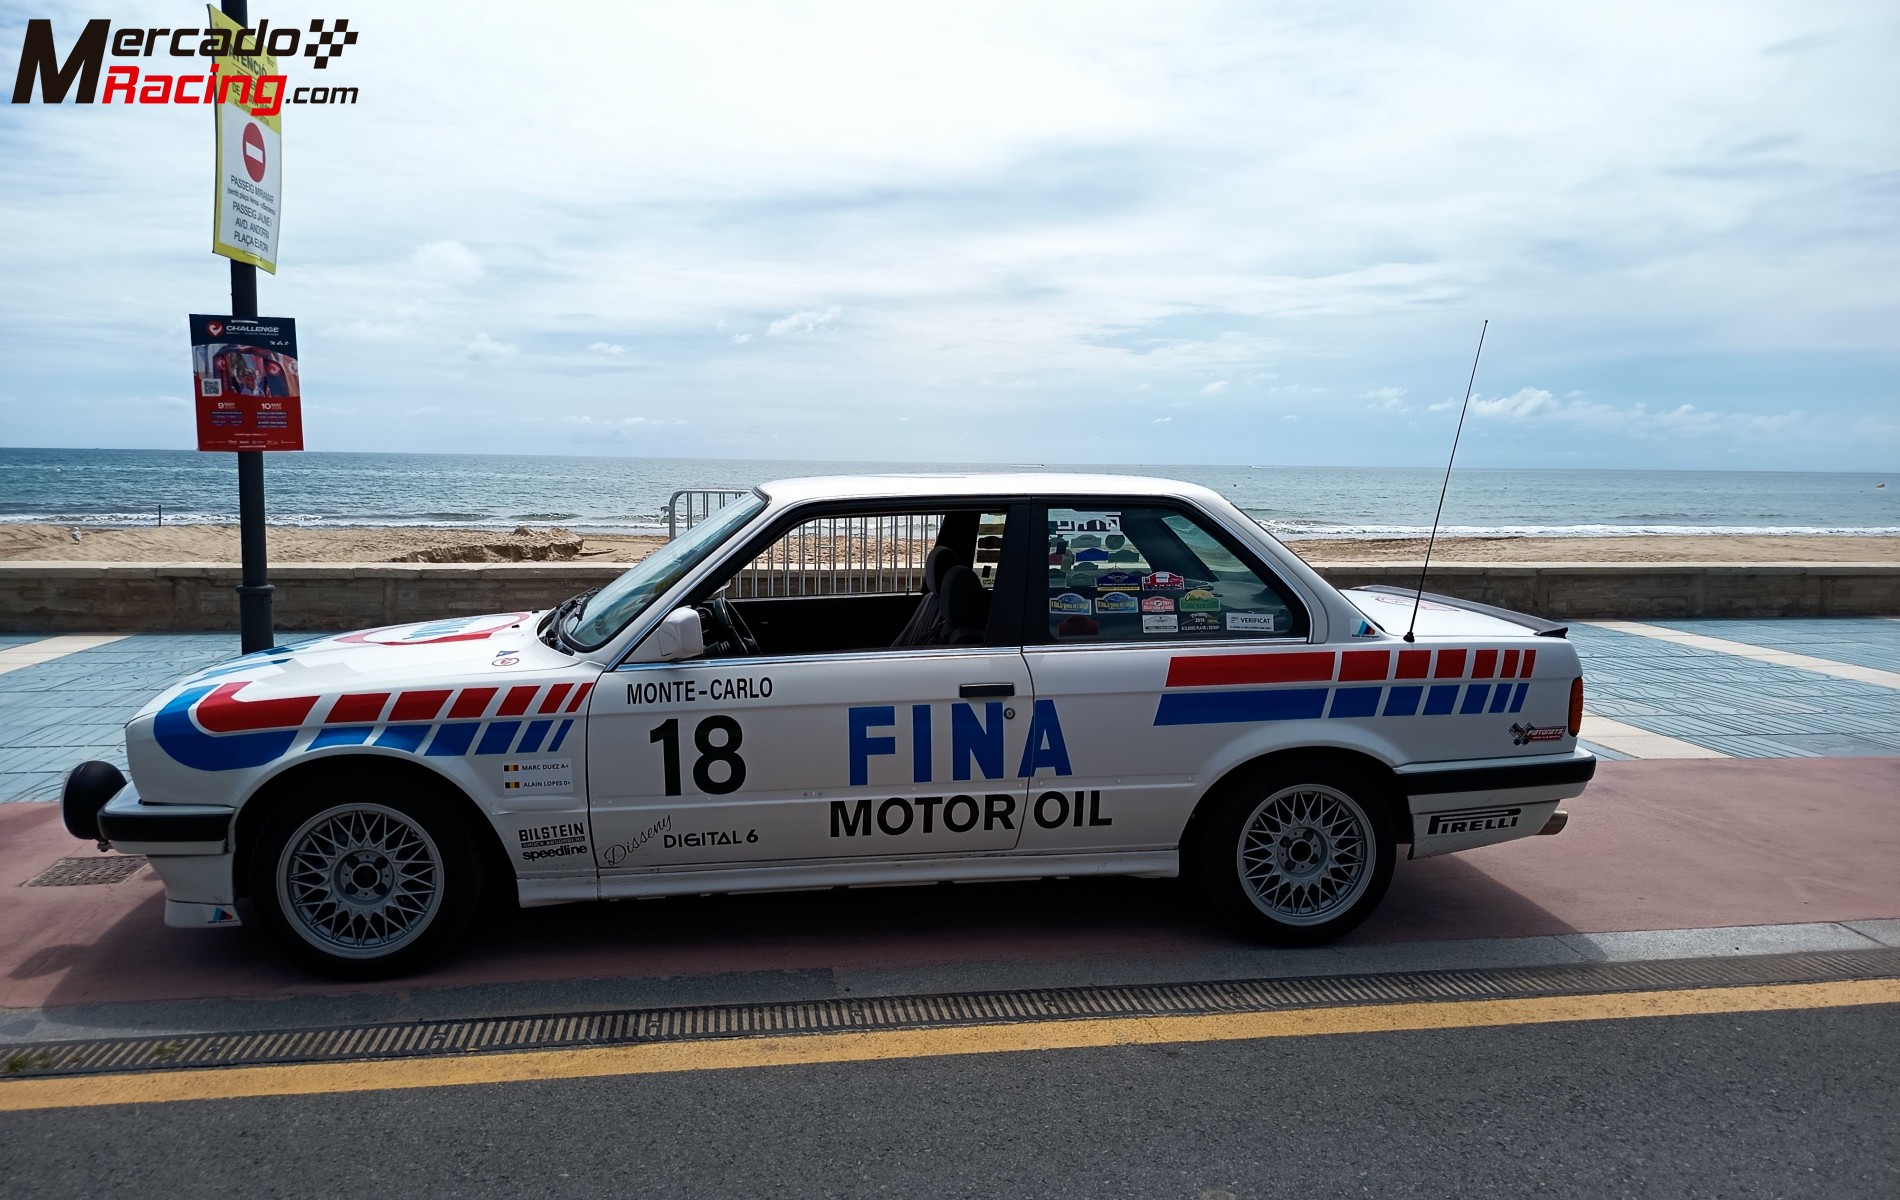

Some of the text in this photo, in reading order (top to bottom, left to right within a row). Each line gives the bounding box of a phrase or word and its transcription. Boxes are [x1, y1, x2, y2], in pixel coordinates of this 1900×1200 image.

[230, 174, 255, 194] PASSEIG
[232, 201, 257, 219] PASSEIG
[235, 217, 249, 230] AVD.
[234, 230, 254, 247] PLAÇA
[226, 325, 280, 333] CHALLENGE
[217, 402, 225, 410] 9
[260, 402, 272, 410] 10
[627, 677, 773, 705] MONTE-CARLO
[848, 699, 1073, 786] FINA
[650, 714, 747, 796] 18
[830, 790, 1113, 838] MOTOR OIL
[1427, 808, 1522, 835] PIRELLI
[518, 822, 585, 842] BILSTEIN
[604, 814, 672, 867] Disseny
[663, 829, 759, 848] DIGITAL 6
[523, 836, 584, 848] SHOCK ABSORBERS
[522, 844, 588, 862] speedline
